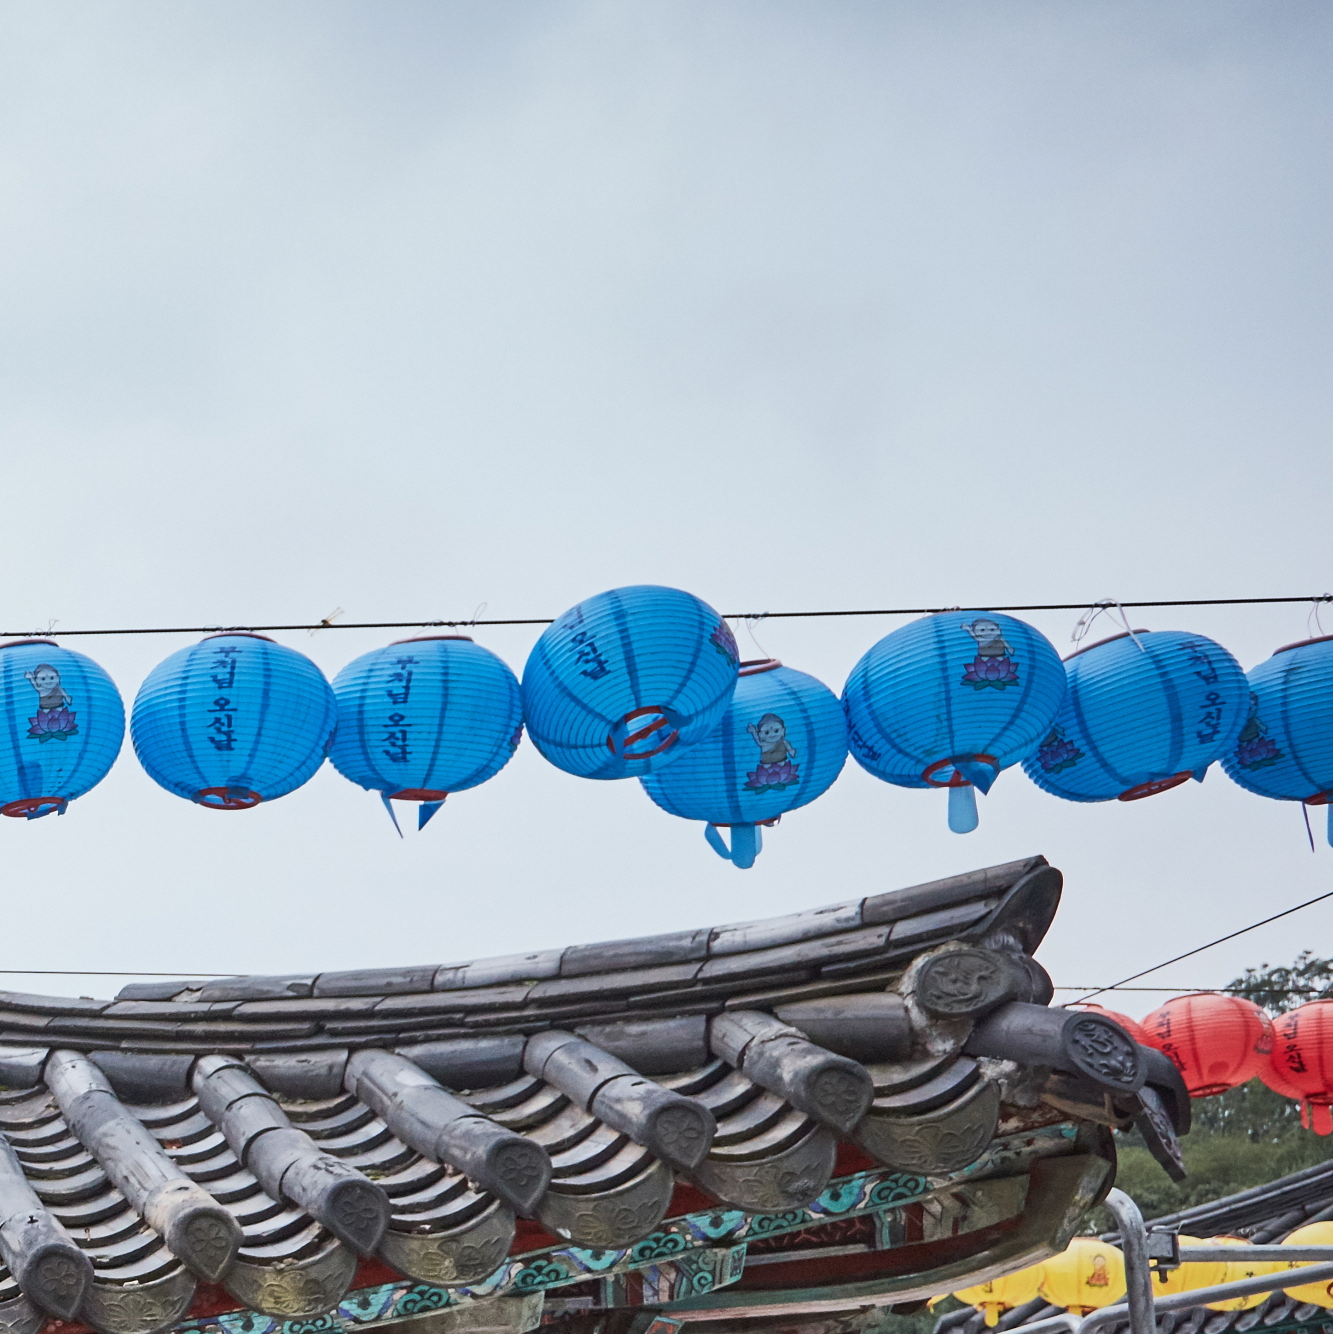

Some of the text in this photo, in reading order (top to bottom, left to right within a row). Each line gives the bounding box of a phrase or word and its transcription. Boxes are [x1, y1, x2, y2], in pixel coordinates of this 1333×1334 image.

[571, 630, 612, 682] 오신날
[207, 645, 242, 752] 부처님 오신날
[382, 656, 420, 763] 부처님 오신날
[1195, 691, 1227, 744] 오신날
